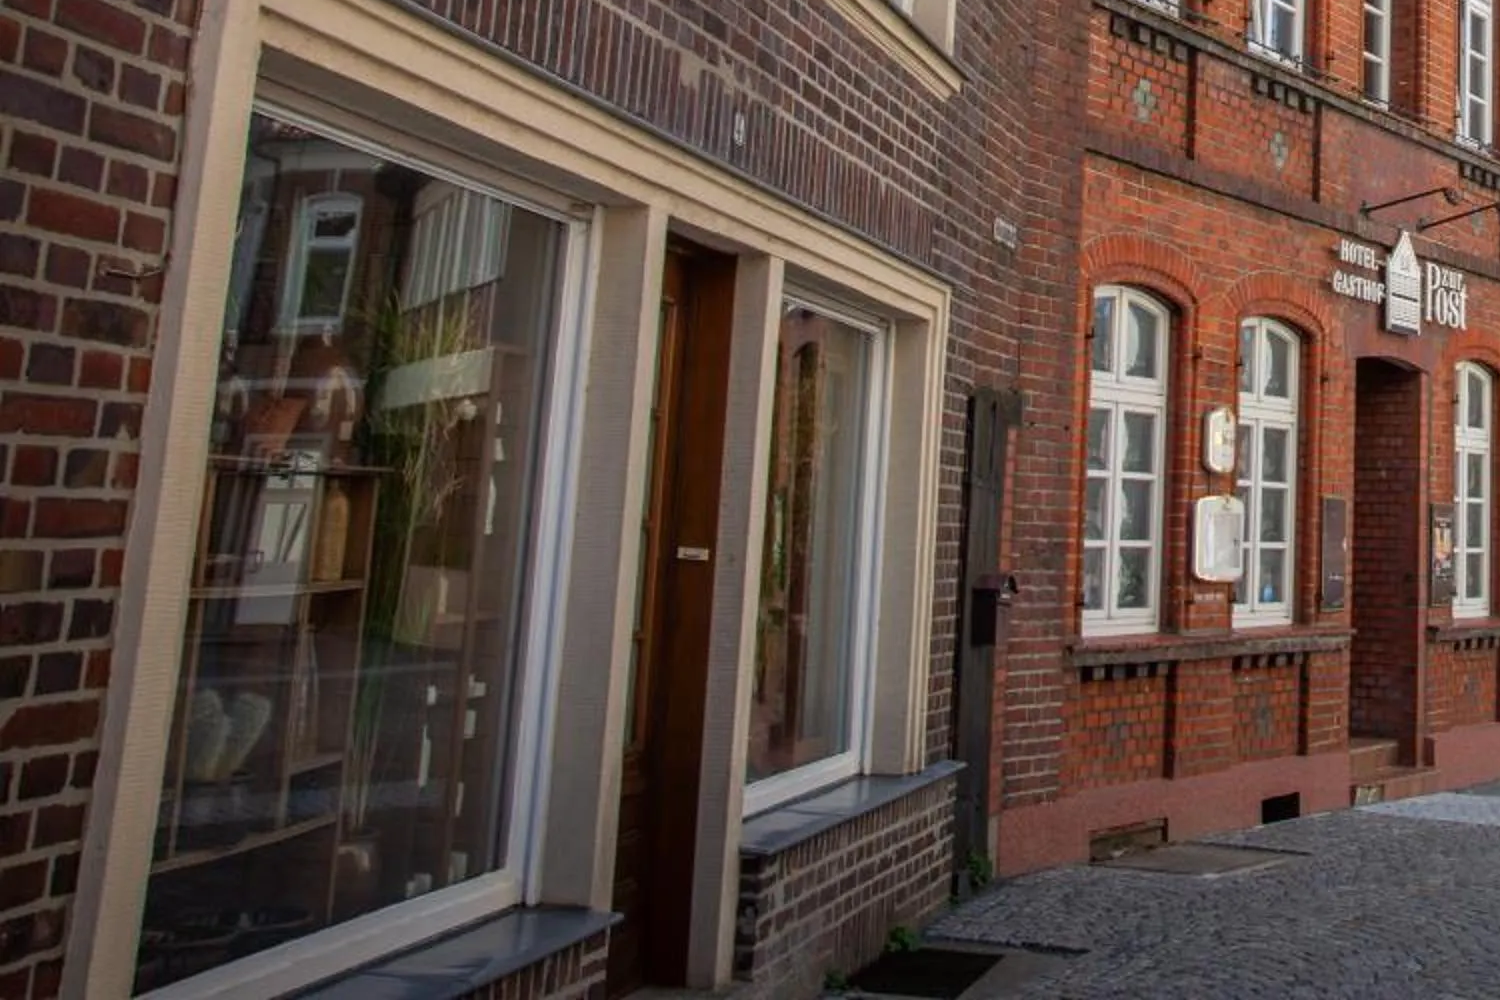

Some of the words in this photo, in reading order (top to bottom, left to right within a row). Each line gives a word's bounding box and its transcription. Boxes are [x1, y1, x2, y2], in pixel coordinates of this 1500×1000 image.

[1341, 239, 1379, 272] HOTEL
[1332, 270, 1385, 304] GASTHOF
[1441, 268, 1463, 290] zur
[1426, 261, 1469, 331] Post
